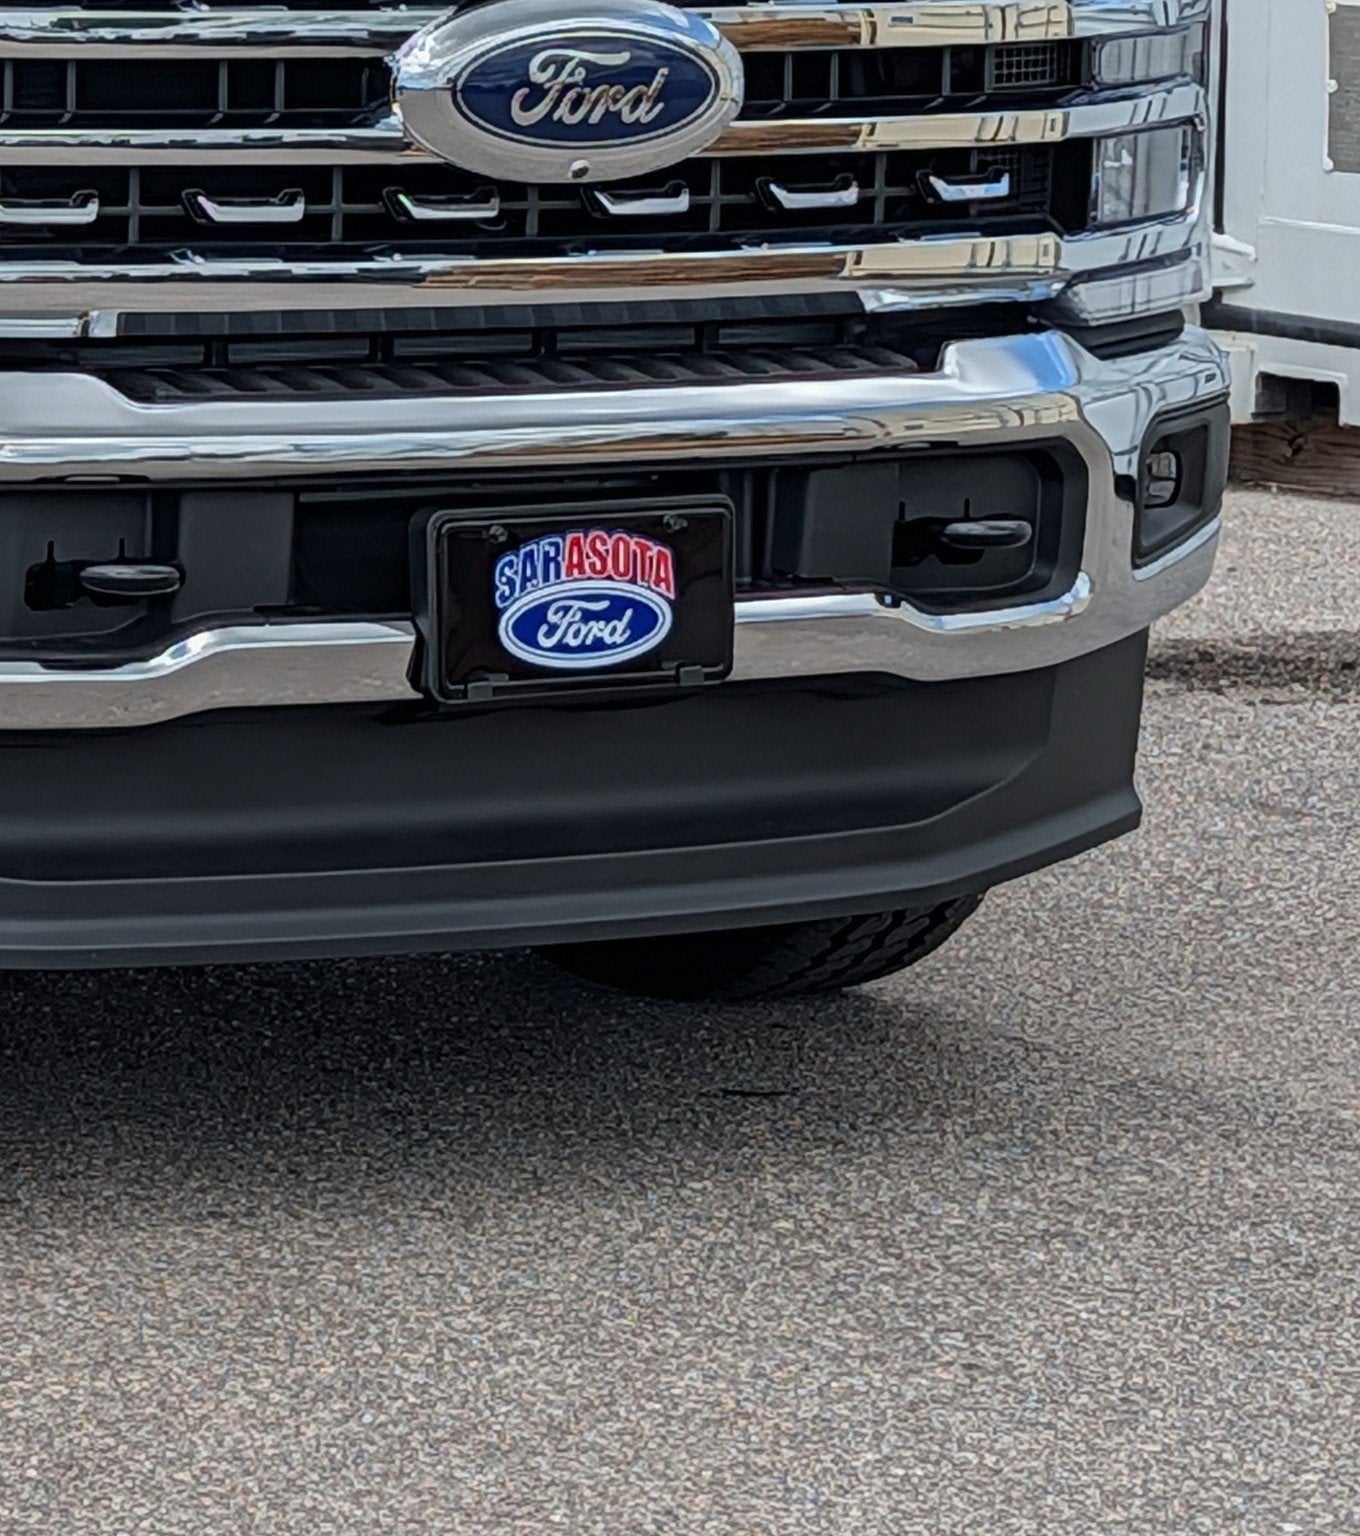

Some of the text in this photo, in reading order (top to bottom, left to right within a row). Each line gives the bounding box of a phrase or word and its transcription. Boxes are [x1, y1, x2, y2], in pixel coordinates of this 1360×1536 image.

[510, 47, 670, 126] Ford
[493, 529, 677, 609] SARASOTA
[536, 598, 635, 649] Ford
